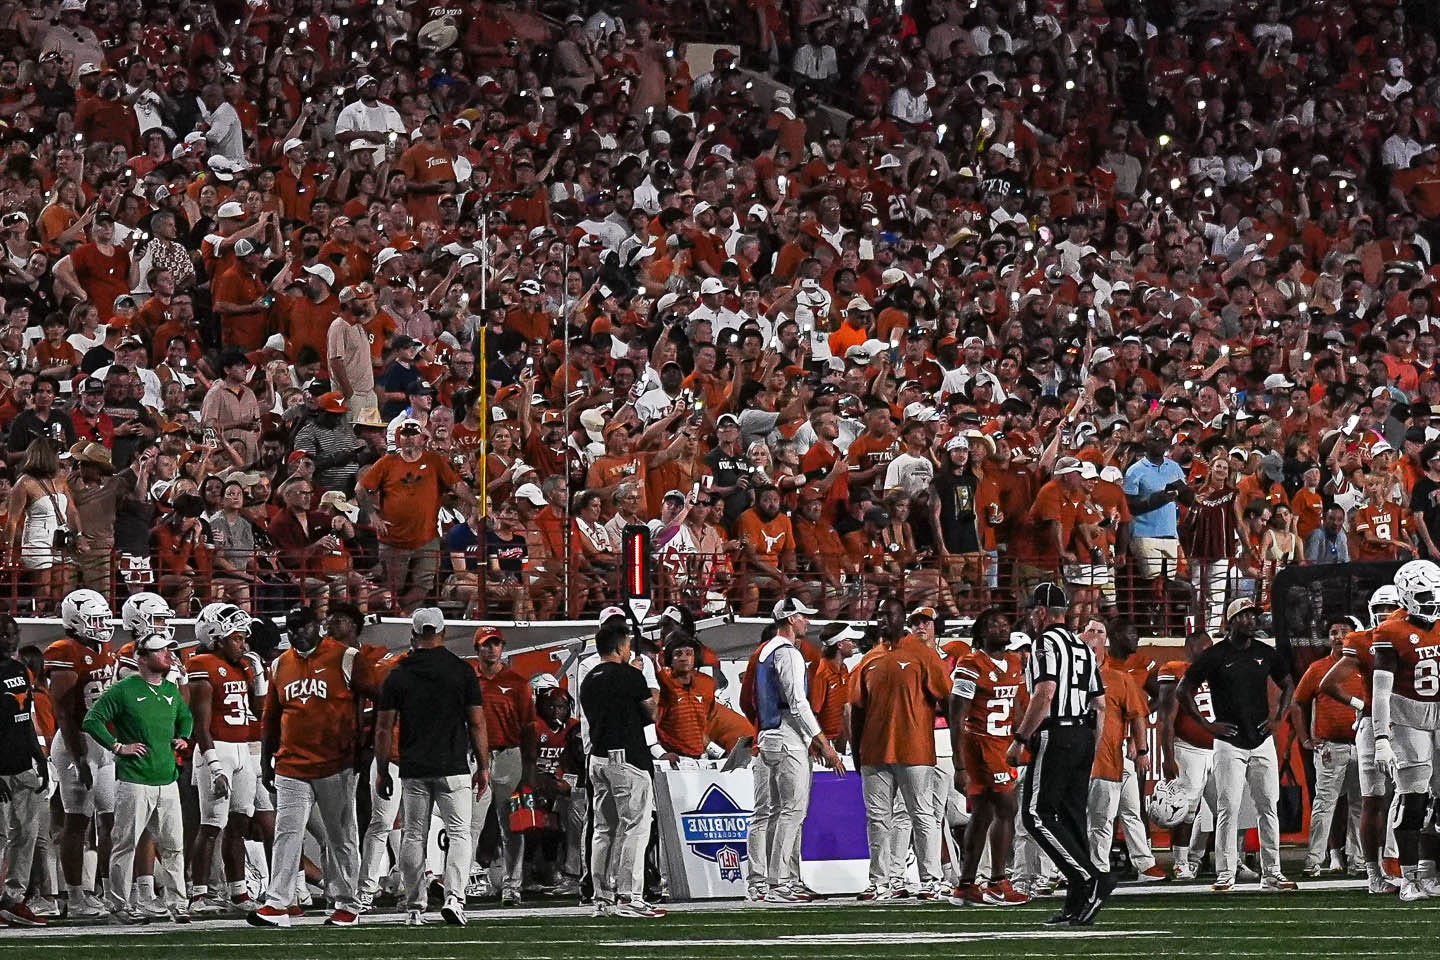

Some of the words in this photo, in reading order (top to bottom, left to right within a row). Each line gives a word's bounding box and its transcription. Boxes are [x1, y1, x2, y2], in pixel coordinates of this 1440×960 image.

[1071, 646, 1088, 685] F
[3, 676, 26, 689] TEXAS
[284, 678, 328, 701] TEXAS
[720, 851, 738, 868] NFL
